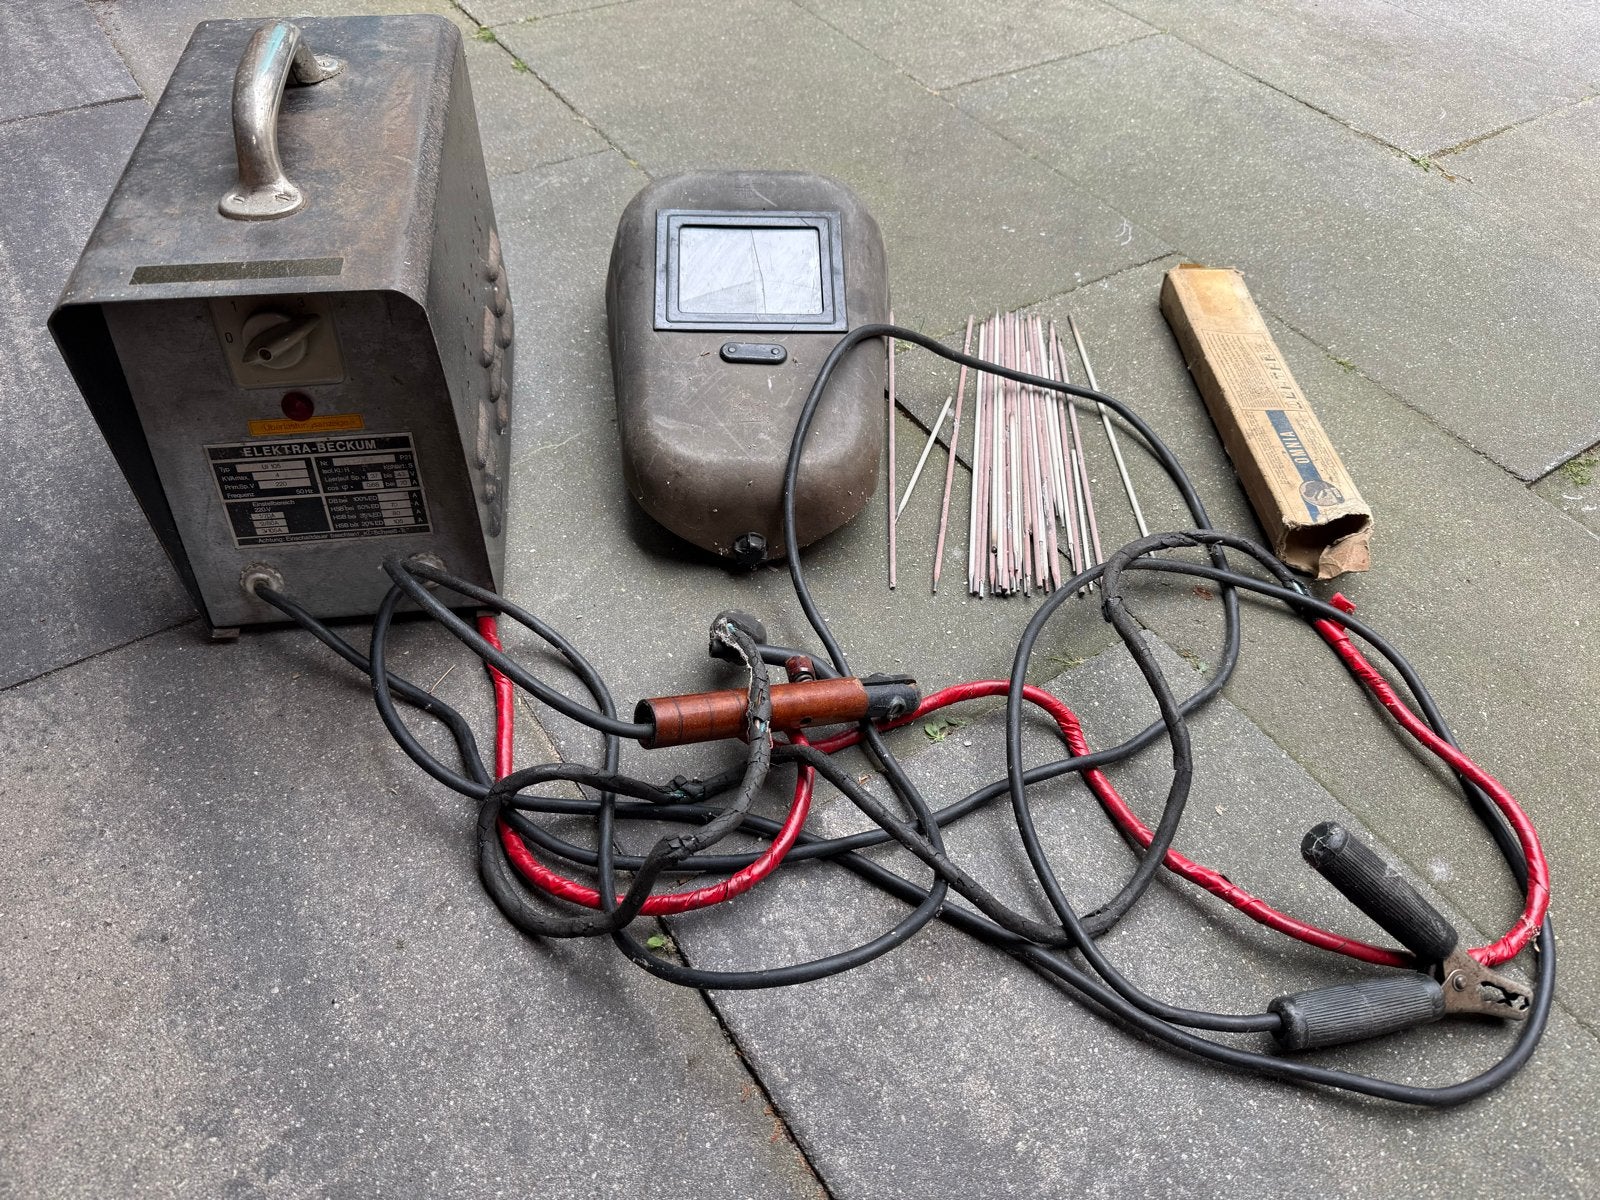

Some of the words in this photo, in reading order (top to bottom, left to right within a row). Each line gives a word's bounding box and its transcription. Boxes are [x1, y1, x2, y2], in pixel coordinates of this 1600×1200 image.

[225, 332, 234, 344] 0
[242, 440, 377, 457] ELEKTRA-BECKUM
[1279, 431, 1310, 464] OMNIA
